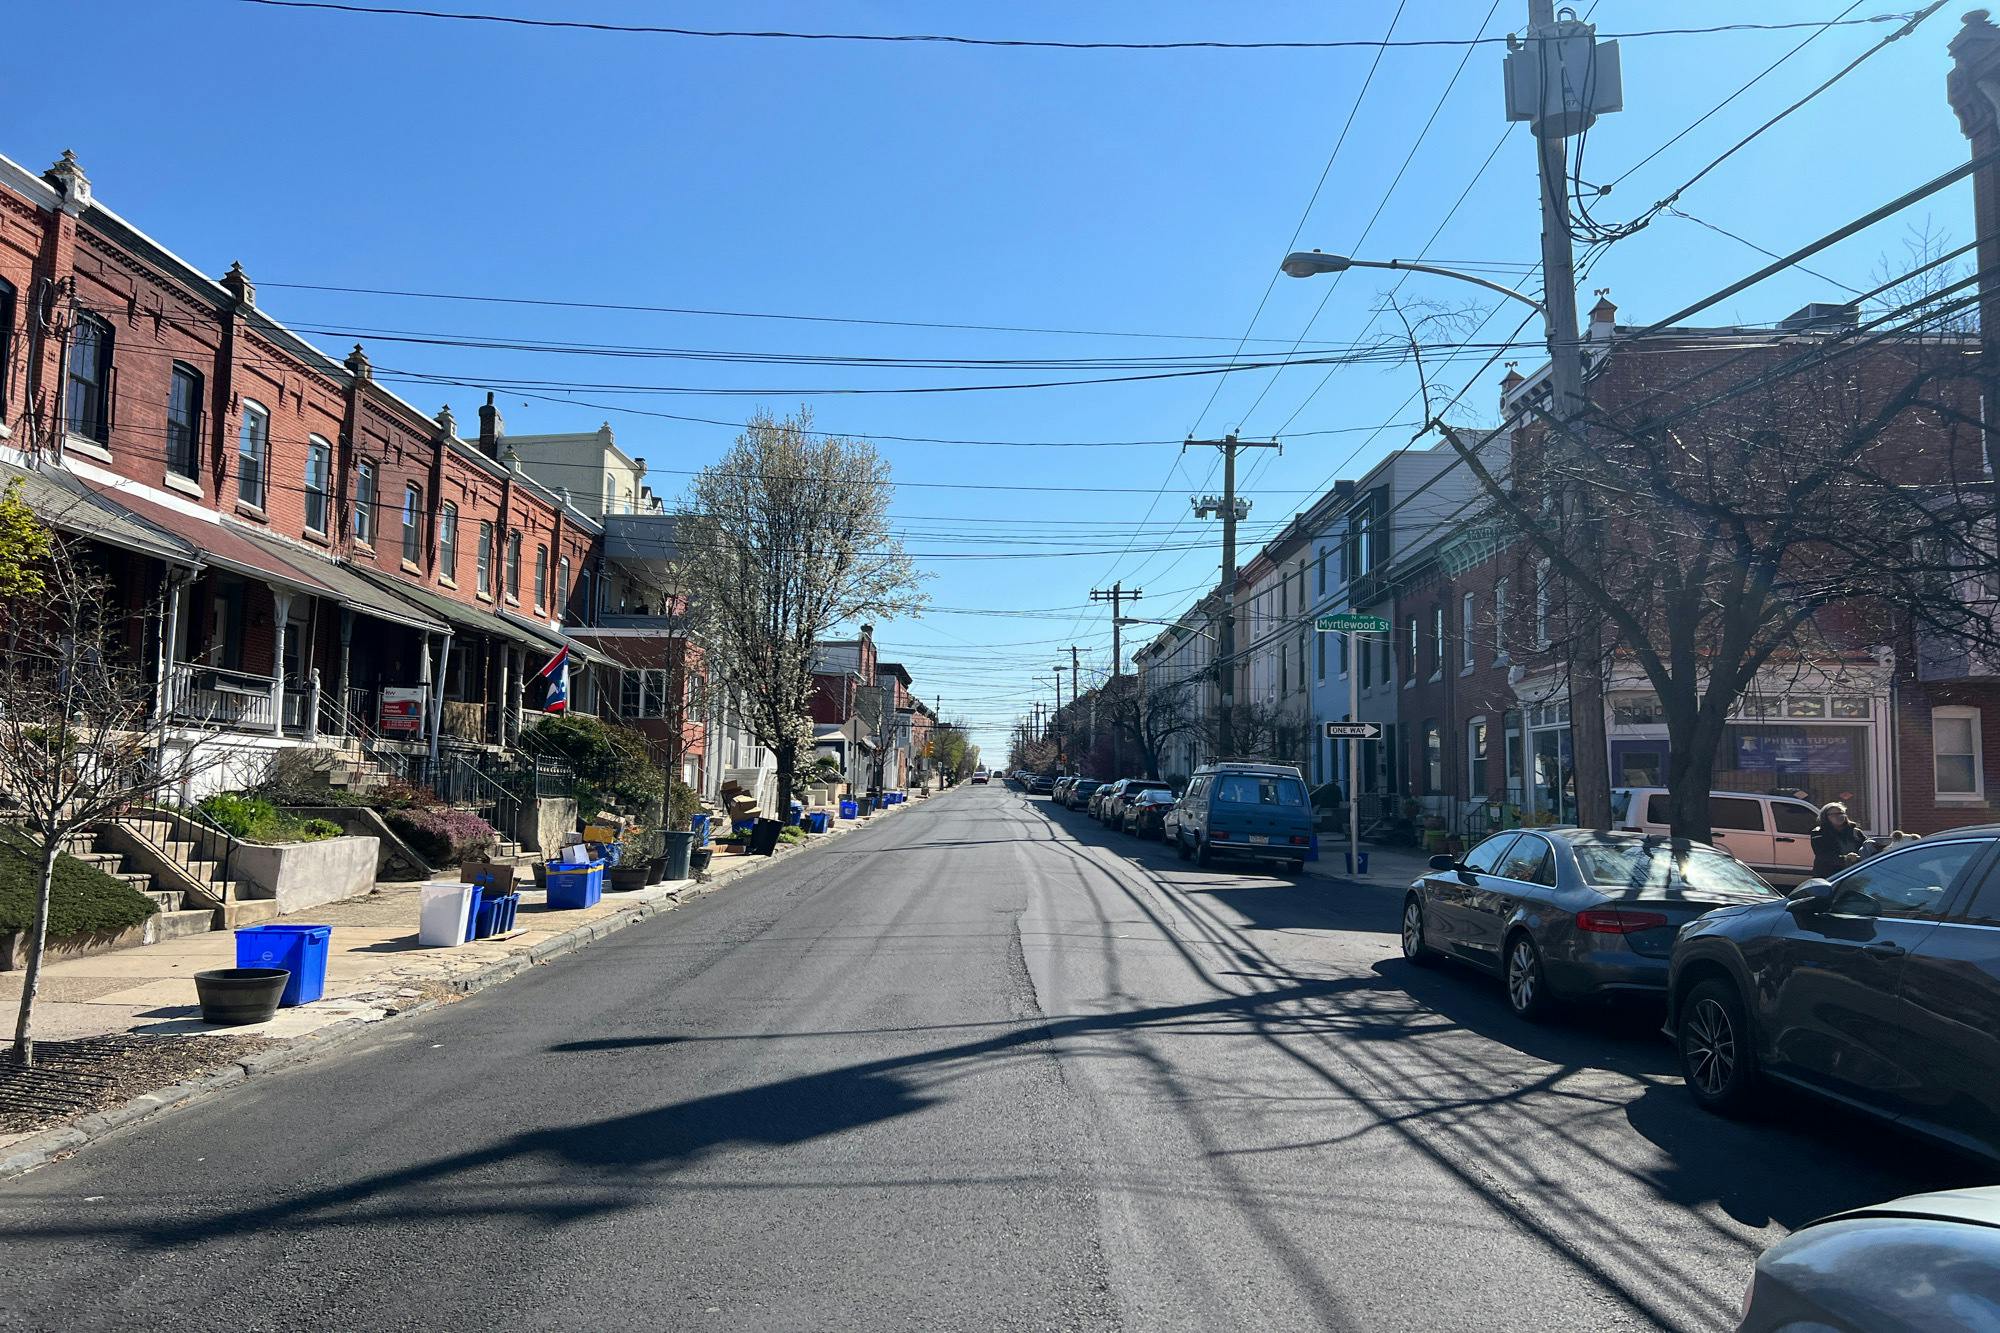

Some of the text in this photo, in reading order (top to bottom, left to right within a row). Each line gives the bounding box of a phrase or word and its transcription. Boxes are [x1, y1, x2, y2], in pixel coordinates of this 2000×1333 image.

[1319, 619, 1389, 630] Myrtlewood St
[1764, 737, 1848, 745] PHILLY TUTORS
